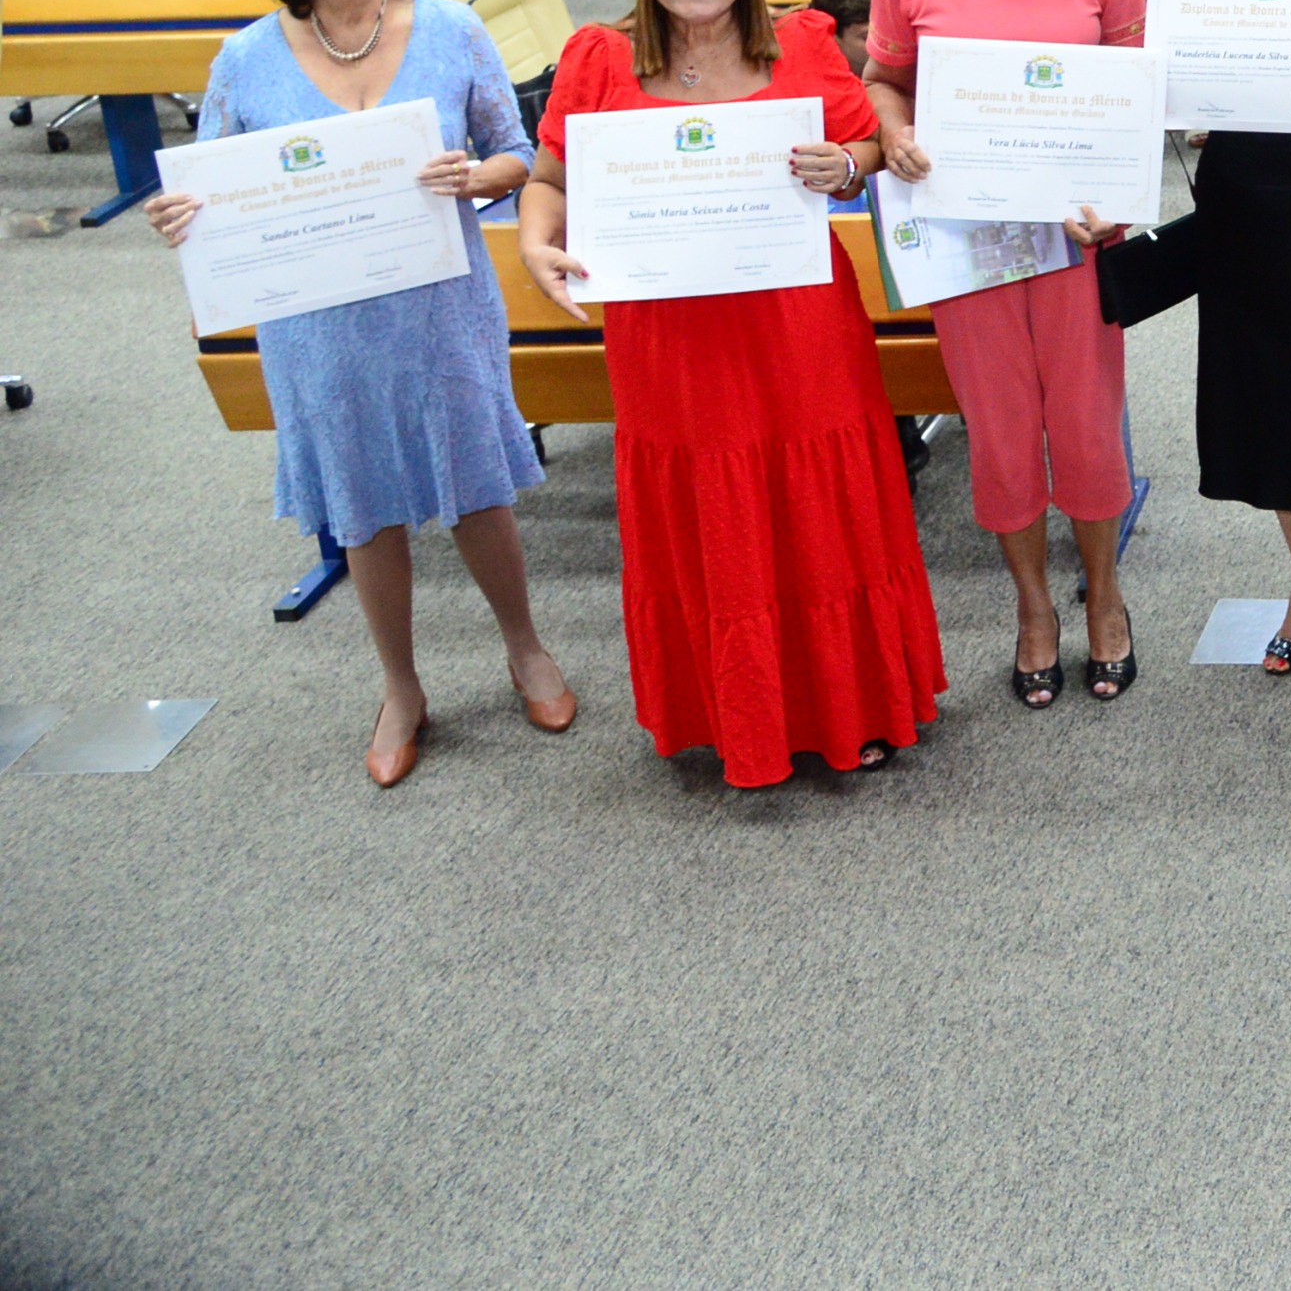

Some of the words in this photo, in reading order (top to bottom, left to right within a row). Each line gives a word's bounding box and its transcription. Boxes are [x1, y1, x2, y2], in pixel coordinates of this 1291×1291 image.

[1180, 2, 1230, 16] Diploma
[1233, 5, 1245, 15] de
[1250, 3, 1286, 16] Honra
[1222, 51, 1254, 60] Lucena
[1255, 52, 1266, 60] da
[1268, 52, 1289, 61] Silva
[954, 88, 1007, 102] Diploma
[1011, 92, 1024, 103] de
[1028, 91, 1068, 104] Honra
[1071, 96, 1086, 105] ao
[1089, 94, 1132, 107] Mérito
[989, 138, 1010, 147] Vera
[1012, 139, 1040, 148] Lúcia
[1042, 140, 1066, 150] Silva
[1068, 141, 1093, 150] Lima
[606, 161, 660, 175] Diploma
[663, 159, 676, 170] de
[681, 156, 722, 169] Honra
[725, 156, 741, 166] ao
[745, 152, 790, 166] Mérito
[660, 208, 689, 217] Maria
[691, 206, 723, 215] Seixas
[726, 204, 739, 213] da
[741, 203, 770, 212] Costa
[261, 229, 299, 244] Sandra
[302, 219, 346, 234] Caetano
[348, 213, 375, 224] Lima
